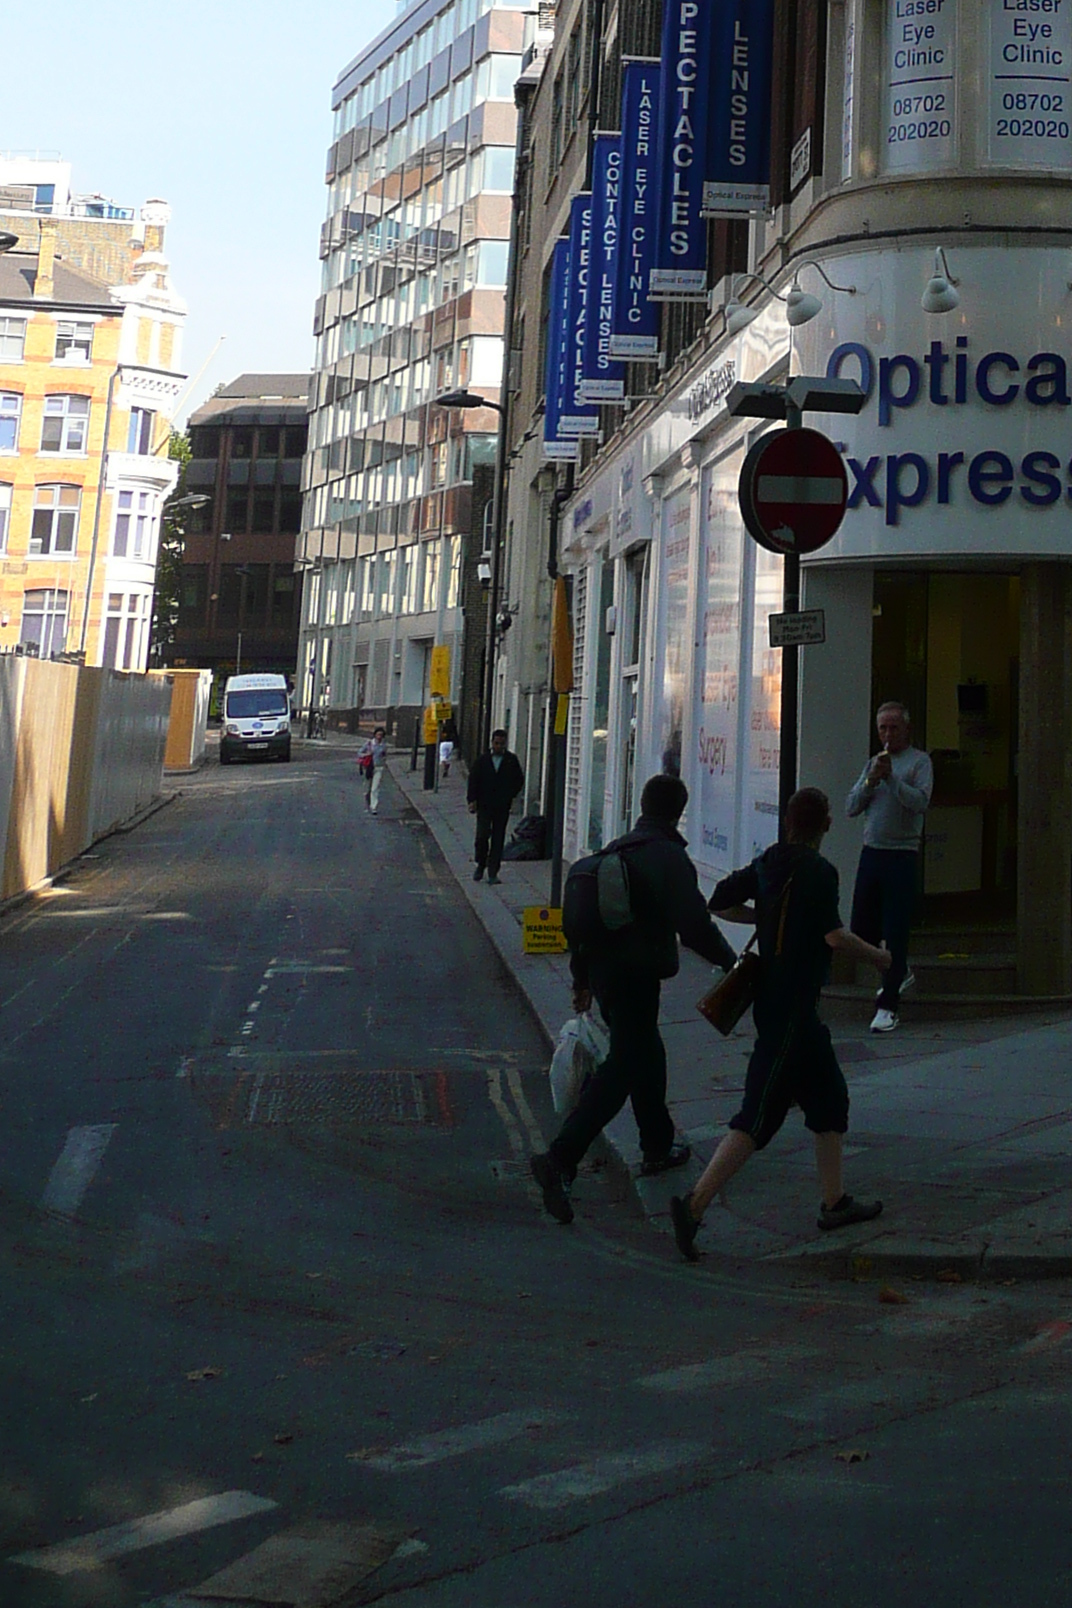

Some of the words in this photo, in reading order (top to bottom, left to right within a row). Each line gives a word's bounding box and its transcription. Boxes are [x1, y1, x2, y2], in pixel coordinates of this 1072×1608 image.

[903, 23, 935, 45] Eye
[1013, 19, 1052, 41] Eye
[894, 48, 944, 69] Clinic
[1003, 44, 1062, 65] Clinic
[729, 21, 748, 166] LENSES
[893, 94, 945, 116] 08702
[1003, 93, 1063, 112] 08702
[636, 79, 651, 155] LASER
[888, 120, 950, 143] 202020
[996, 120, 1069, 139] 202020
[633, 169, 647, 214] EYE
[604, 152, 620, 260] CONTACT
[627, 227, 645, 322] CLINIC
[597, 274, 612, 369] LENSES
[699, 727, 727, 775] Surgery
